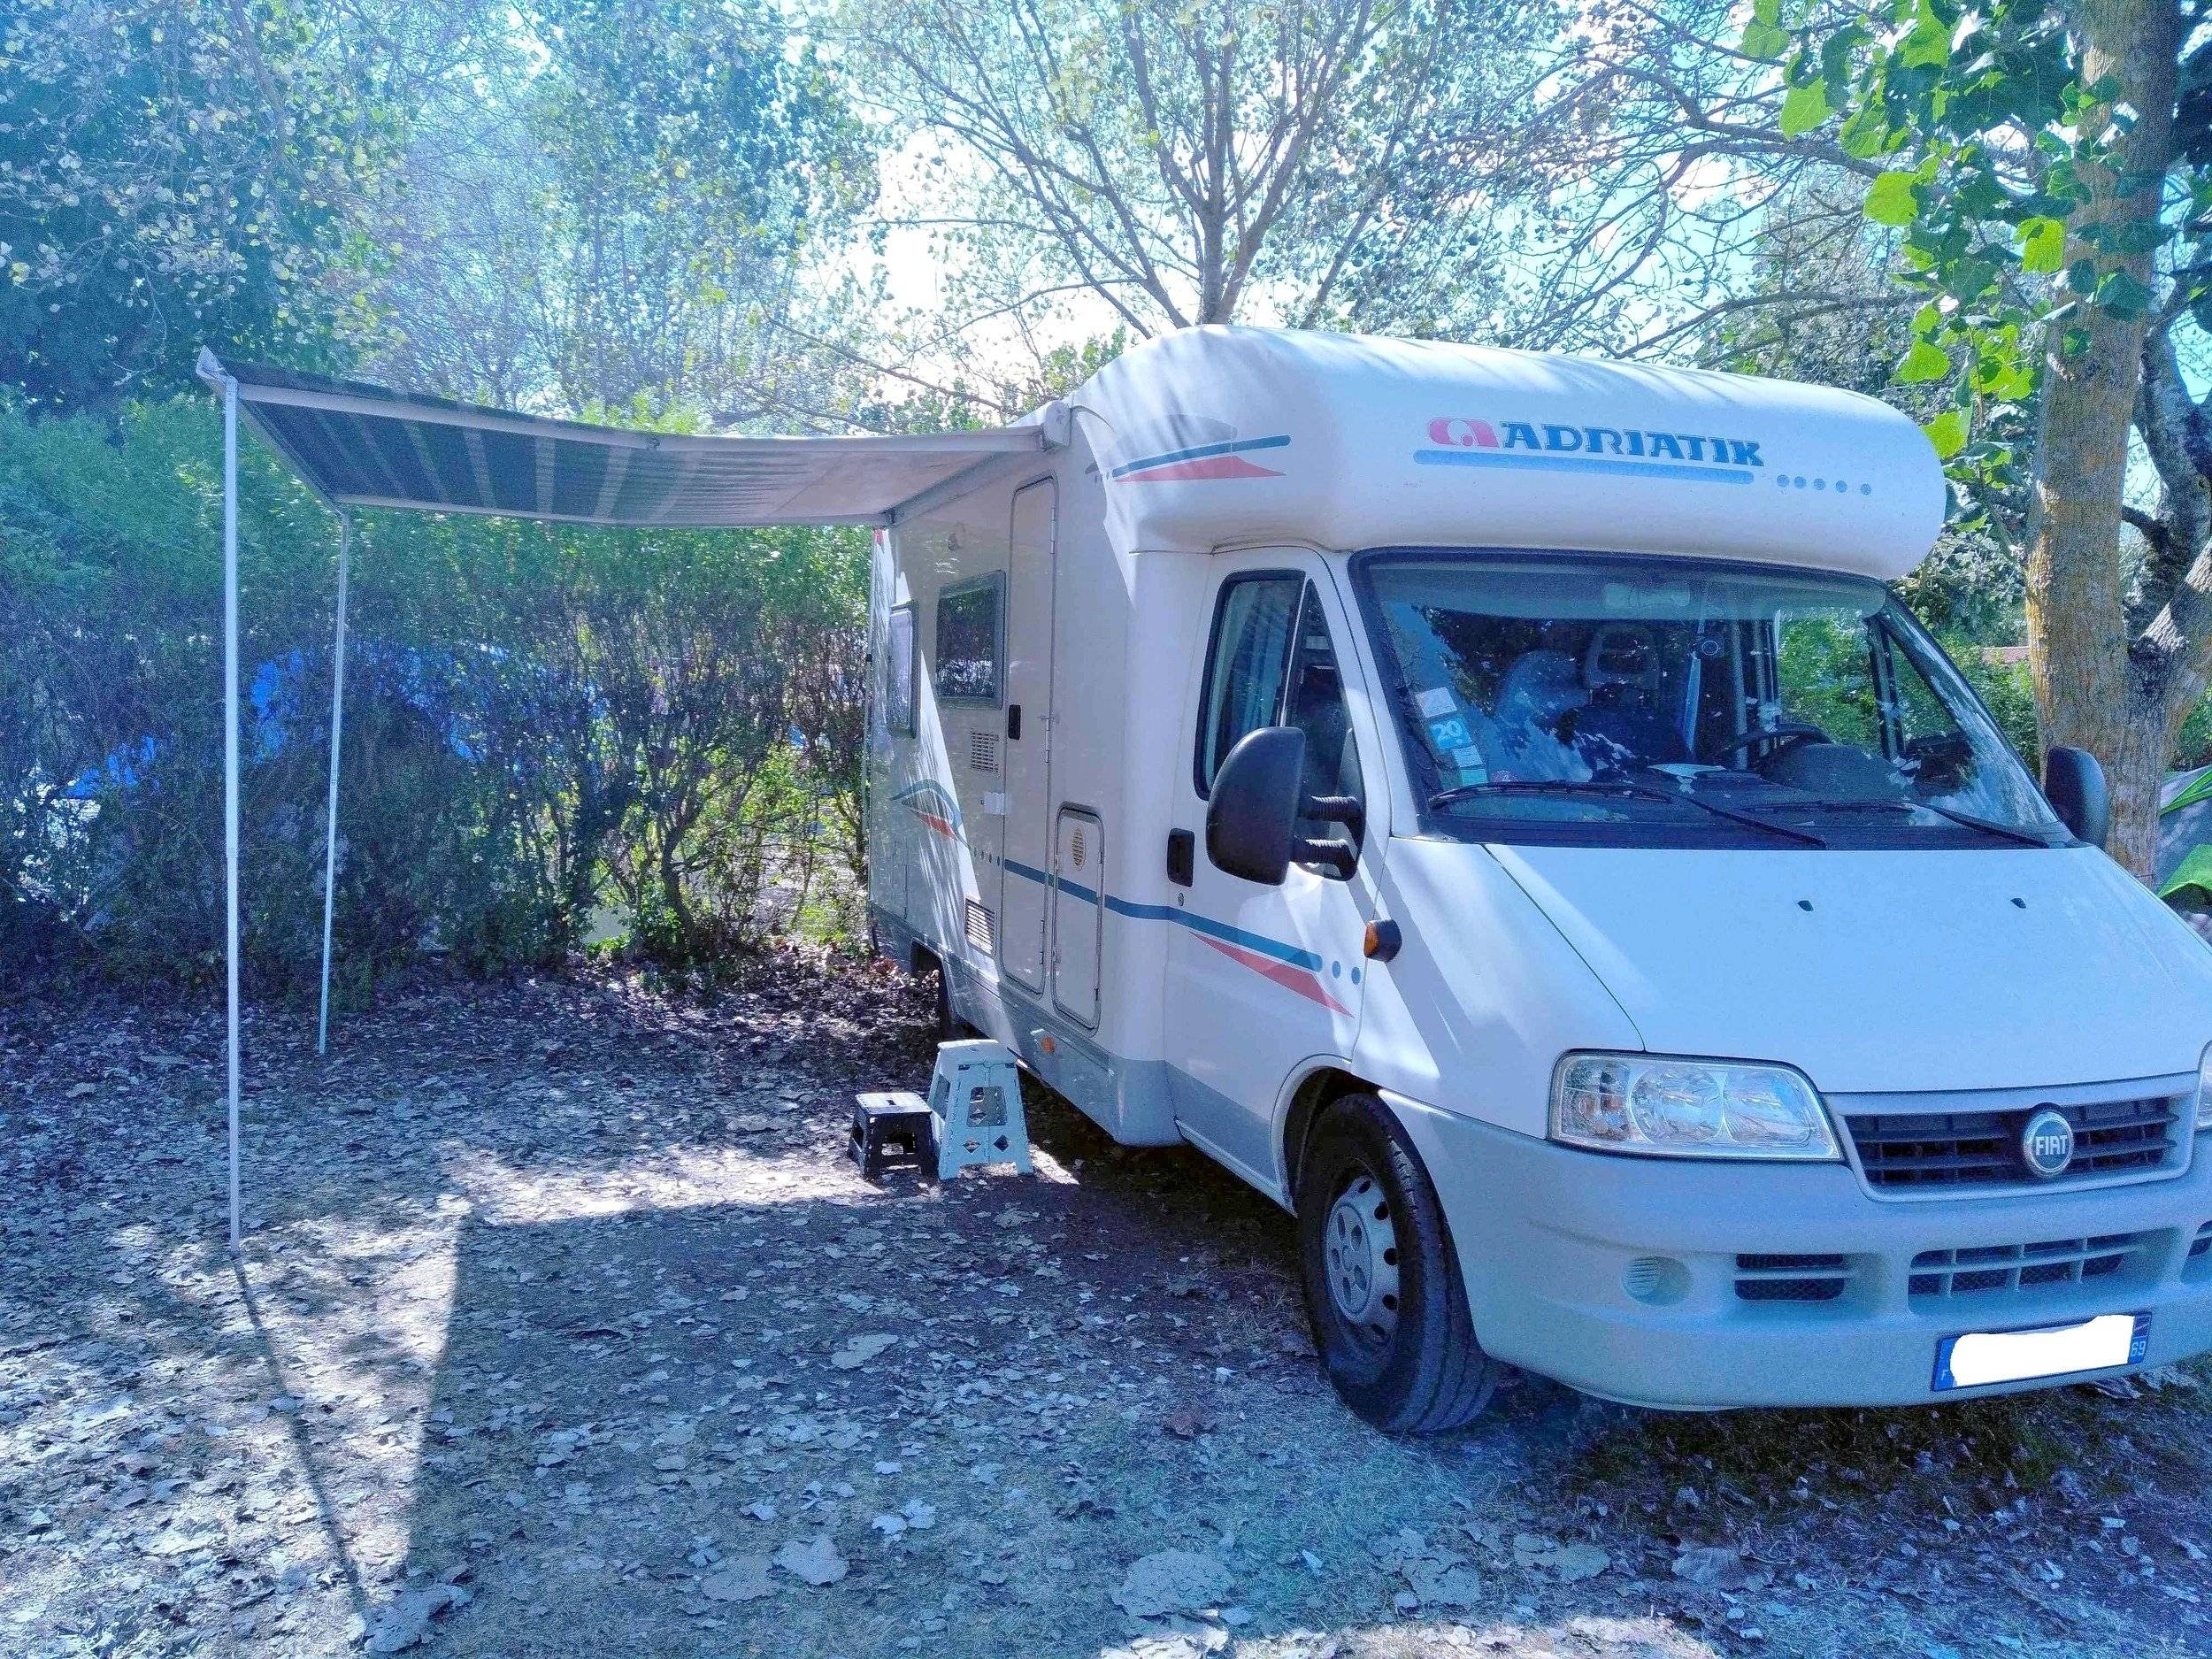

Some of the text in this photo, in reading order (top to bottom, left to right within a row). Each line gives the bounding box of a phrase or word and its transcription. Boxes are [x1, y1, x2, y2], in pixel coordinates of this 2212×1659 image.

[1500, 420, 1763, 466] ADRIATIK
[1430, 720, 1463, 741] 20
[2035, 1134, 2068, 1156] FIAT
[2131, 1340, 2147, 1356] 69
